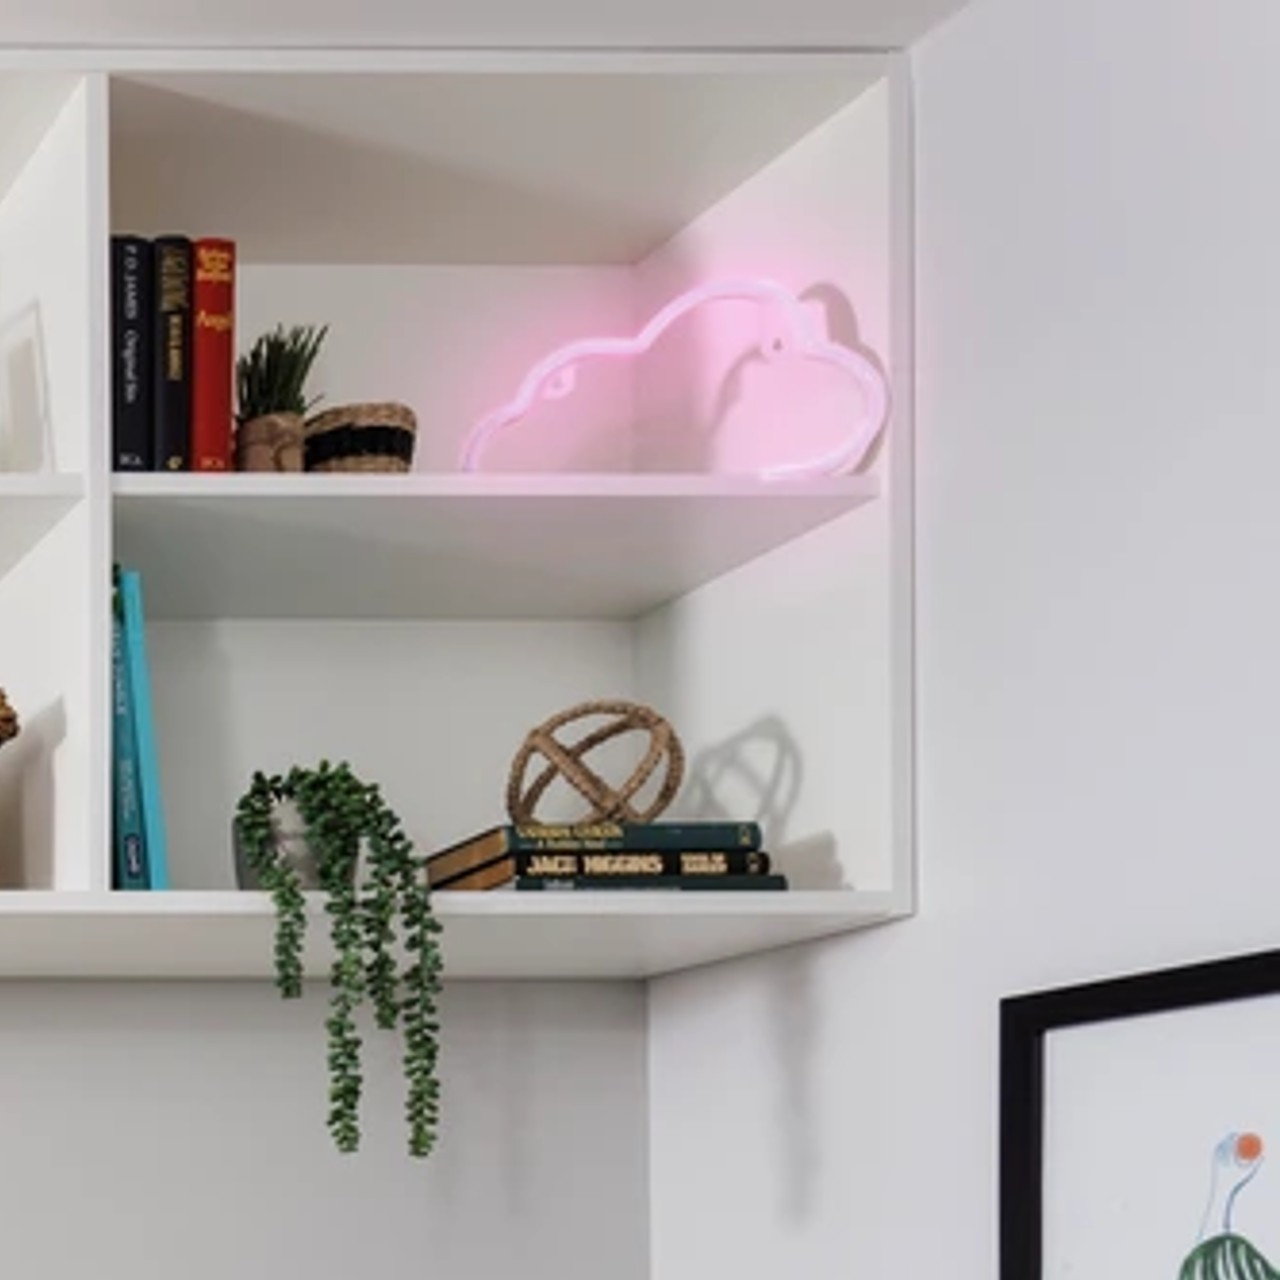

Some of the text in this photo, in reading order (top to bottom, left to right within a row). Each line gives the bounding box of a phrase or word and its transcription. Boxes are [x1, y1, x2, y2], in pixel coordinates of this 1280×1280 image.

[124, 275, 138, 319] JAMES
[122, 330, 139, 379] Original
[526, 854, 577, 875] JACK
[583, 854, 663, 875] HIGGINS
